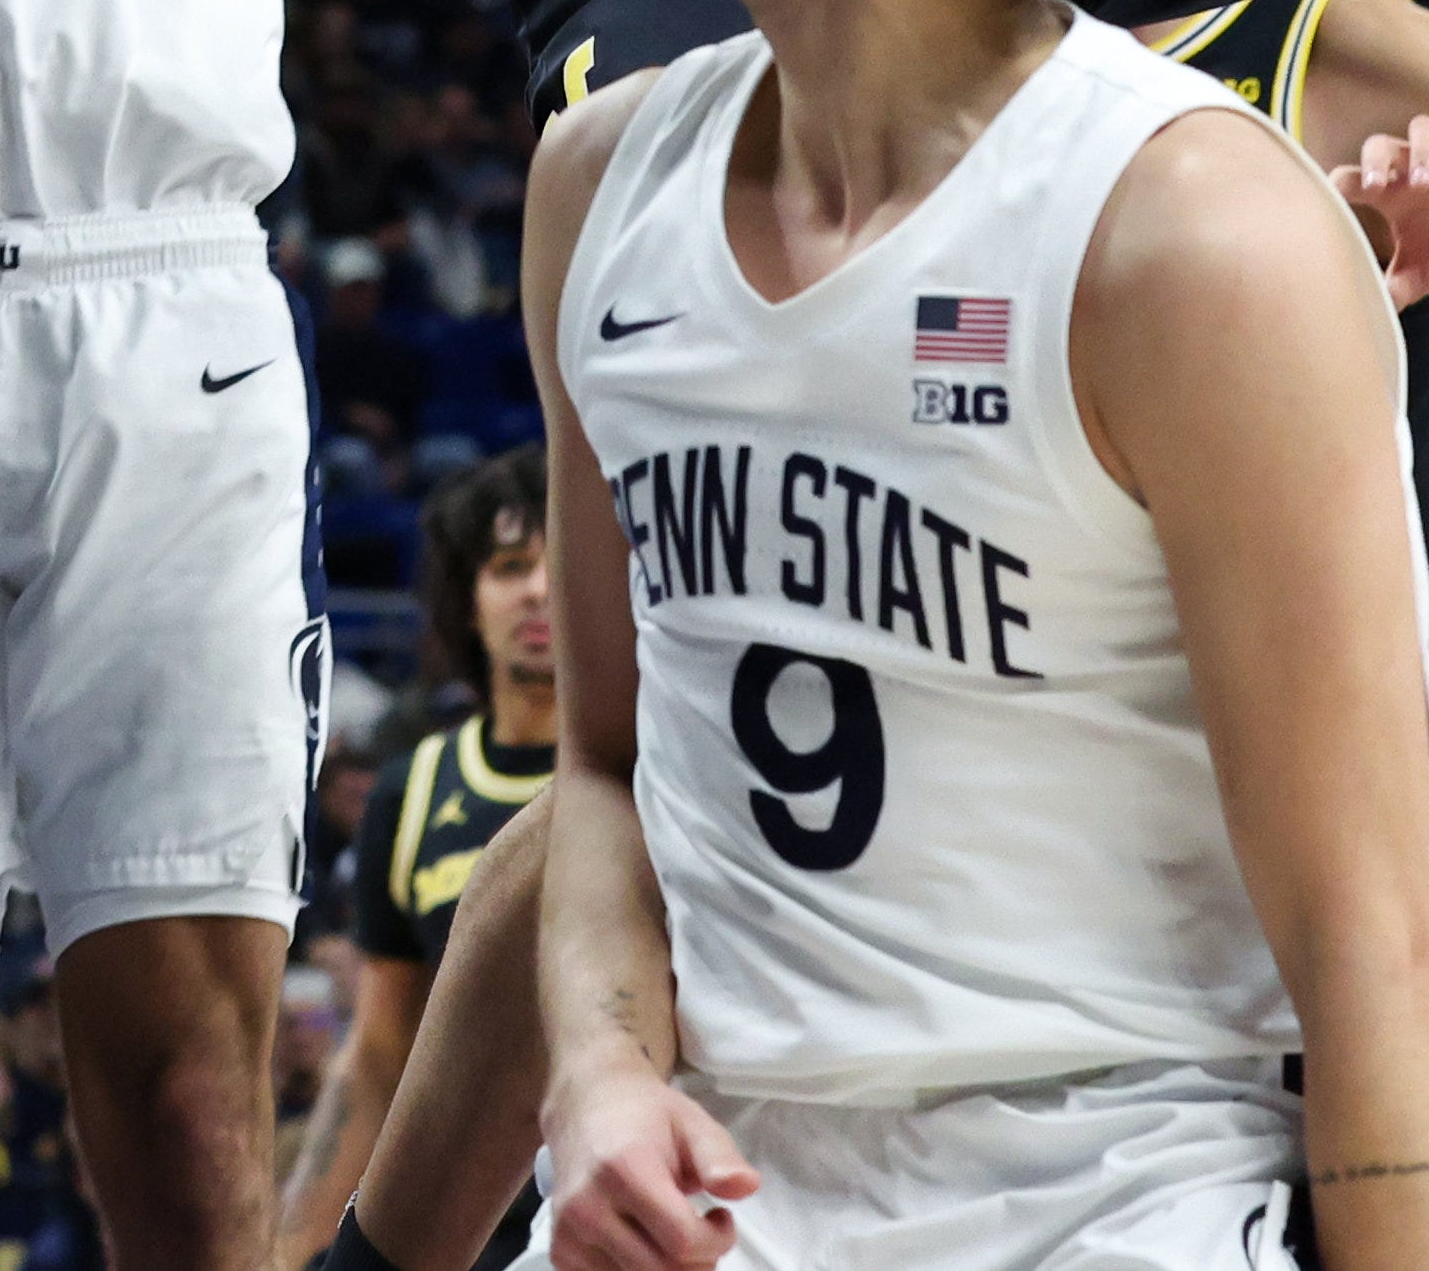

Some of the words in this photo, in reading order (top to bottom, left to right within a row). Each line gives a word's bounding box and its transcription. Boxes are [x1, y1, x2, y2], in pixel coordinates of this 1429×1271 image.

[610, 444, 752, 608] ENN
[779, 451, 1045, 680] STATE
[730, 642, 886, 872] 9
